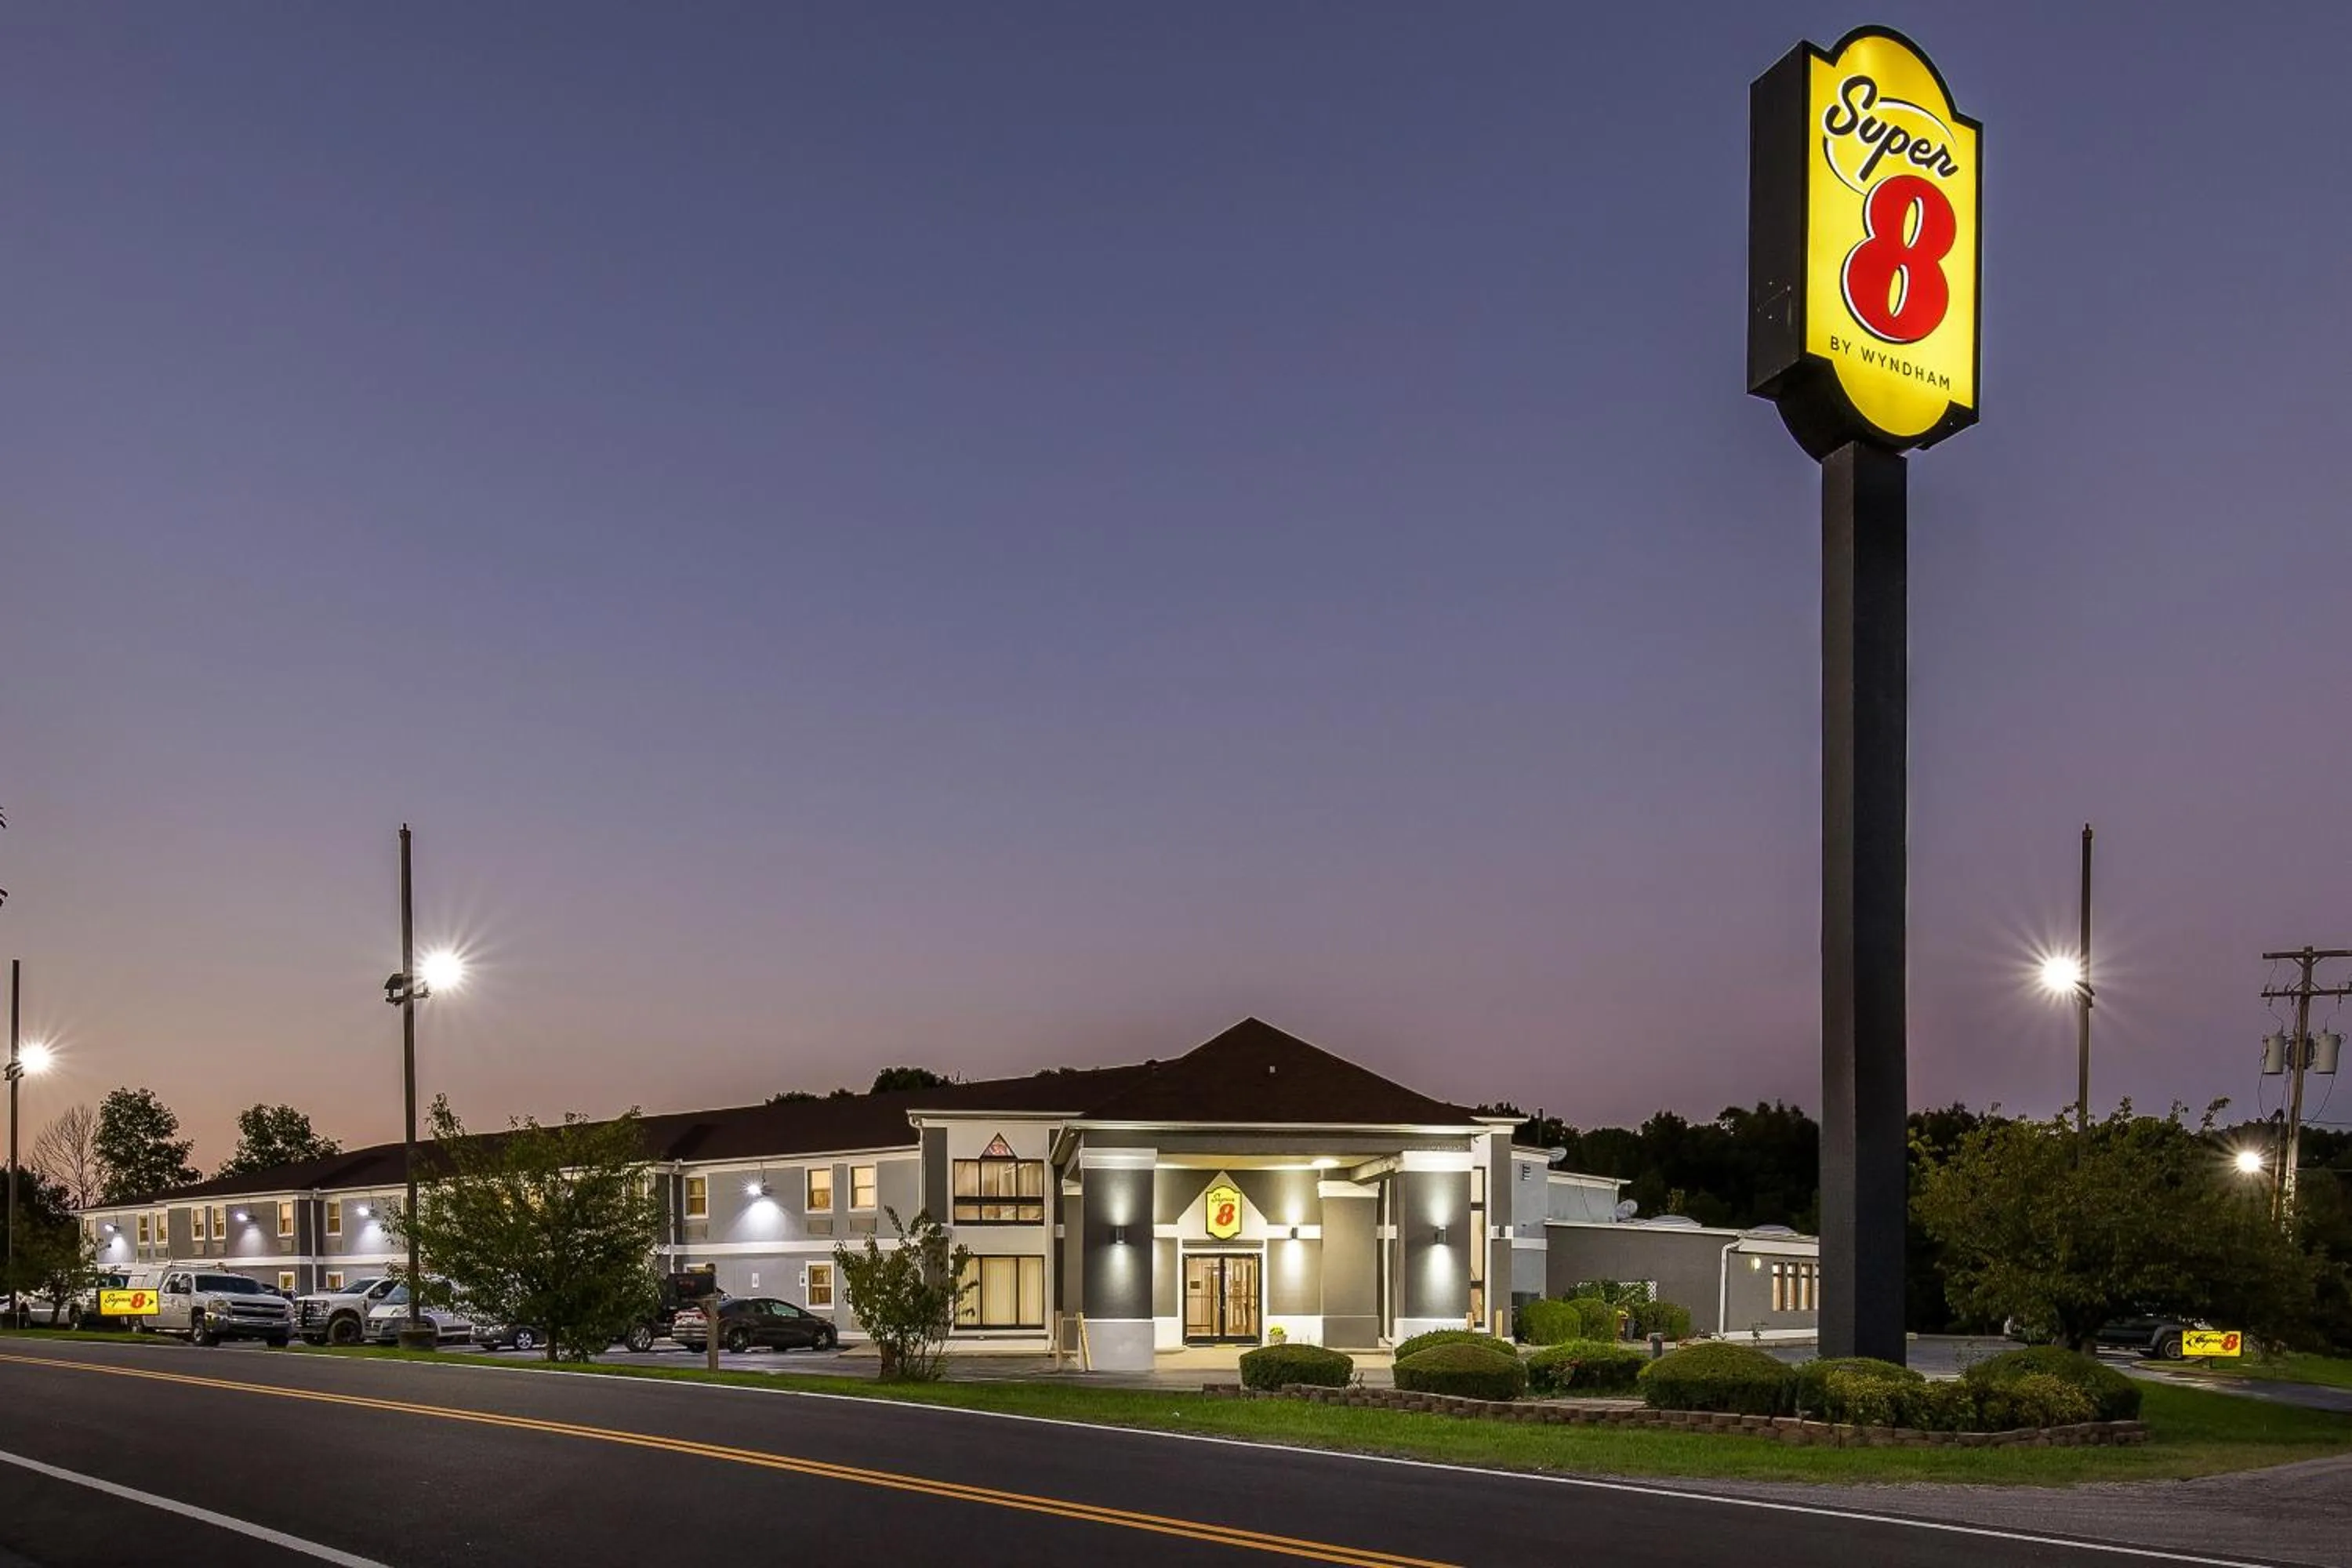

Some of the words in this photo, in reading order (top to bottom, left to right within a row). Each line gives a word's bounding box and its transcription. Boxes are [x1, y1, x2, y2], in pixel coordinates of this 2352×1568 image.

[1825, 74, 1959, 182] Super
[1840, 175, 1956, 344] 8
[1831, 336, 1851, 355] BY
[1860, 346, 1950, 390] WYNDHAM
[1216, 1203, 1236, 1226] 8
[131, 1292, 145, 1308] 8
[2222, 1334, 2238, 1350] 8
